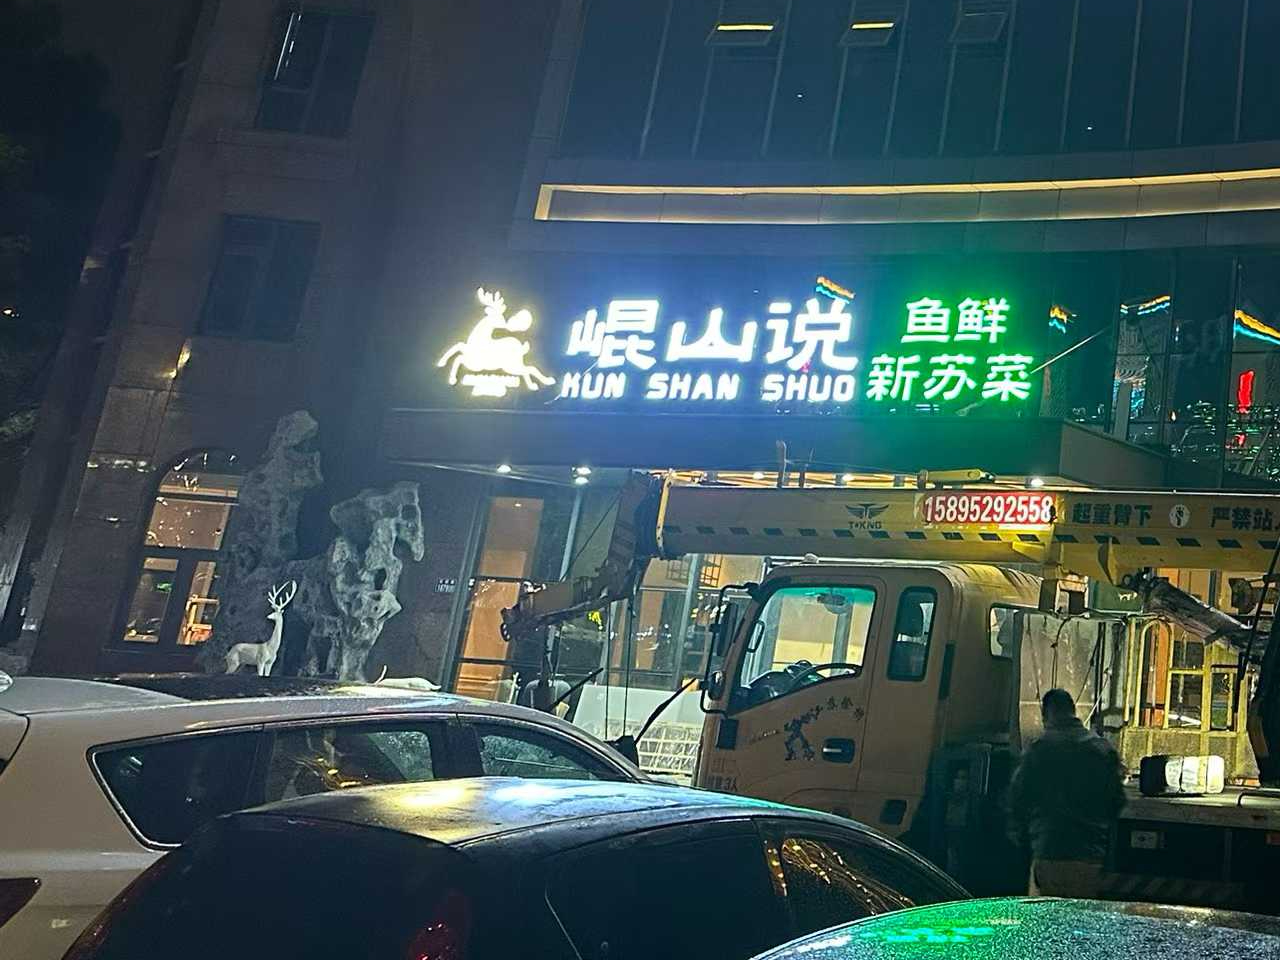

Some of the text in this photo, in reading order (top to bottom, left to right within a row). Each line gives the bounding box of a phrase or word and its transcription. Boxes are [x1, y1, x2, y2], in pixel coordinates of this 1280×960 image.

[903, 296, 1011, 344] 鱼鲜
[560, 372, 856, 402] KUN SHAN SHUO
[866, 352, 1036, 403] 新苏菜
[924, 495, 1054, 525] 15895292558
